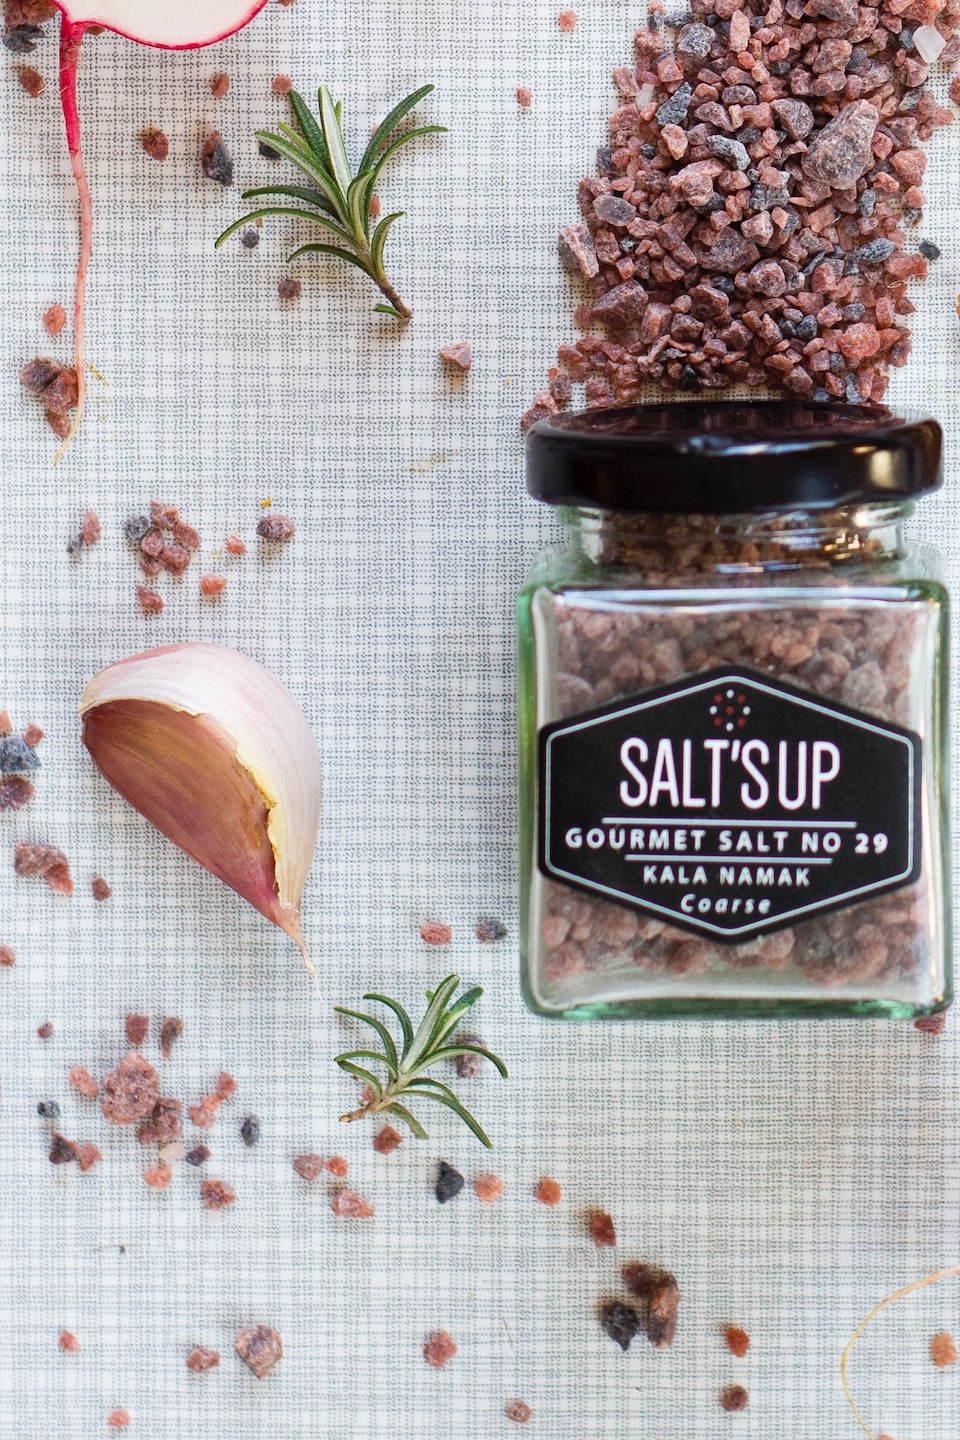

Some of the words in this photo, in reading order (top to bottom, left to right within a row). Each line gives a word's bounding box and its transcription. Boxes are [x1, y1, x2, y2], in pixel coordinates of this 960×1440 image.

[564, 827, 707, 850] GOURMET
[719, 830, 791, 852] SALT
[802, 832, 842, 853] NO
[854, 832, 889, 854] 29
[643, 865, 708, 885] KALA
[720, 866, 811, 886] NAMAK
[680, 893, 772, 914] Coarse
